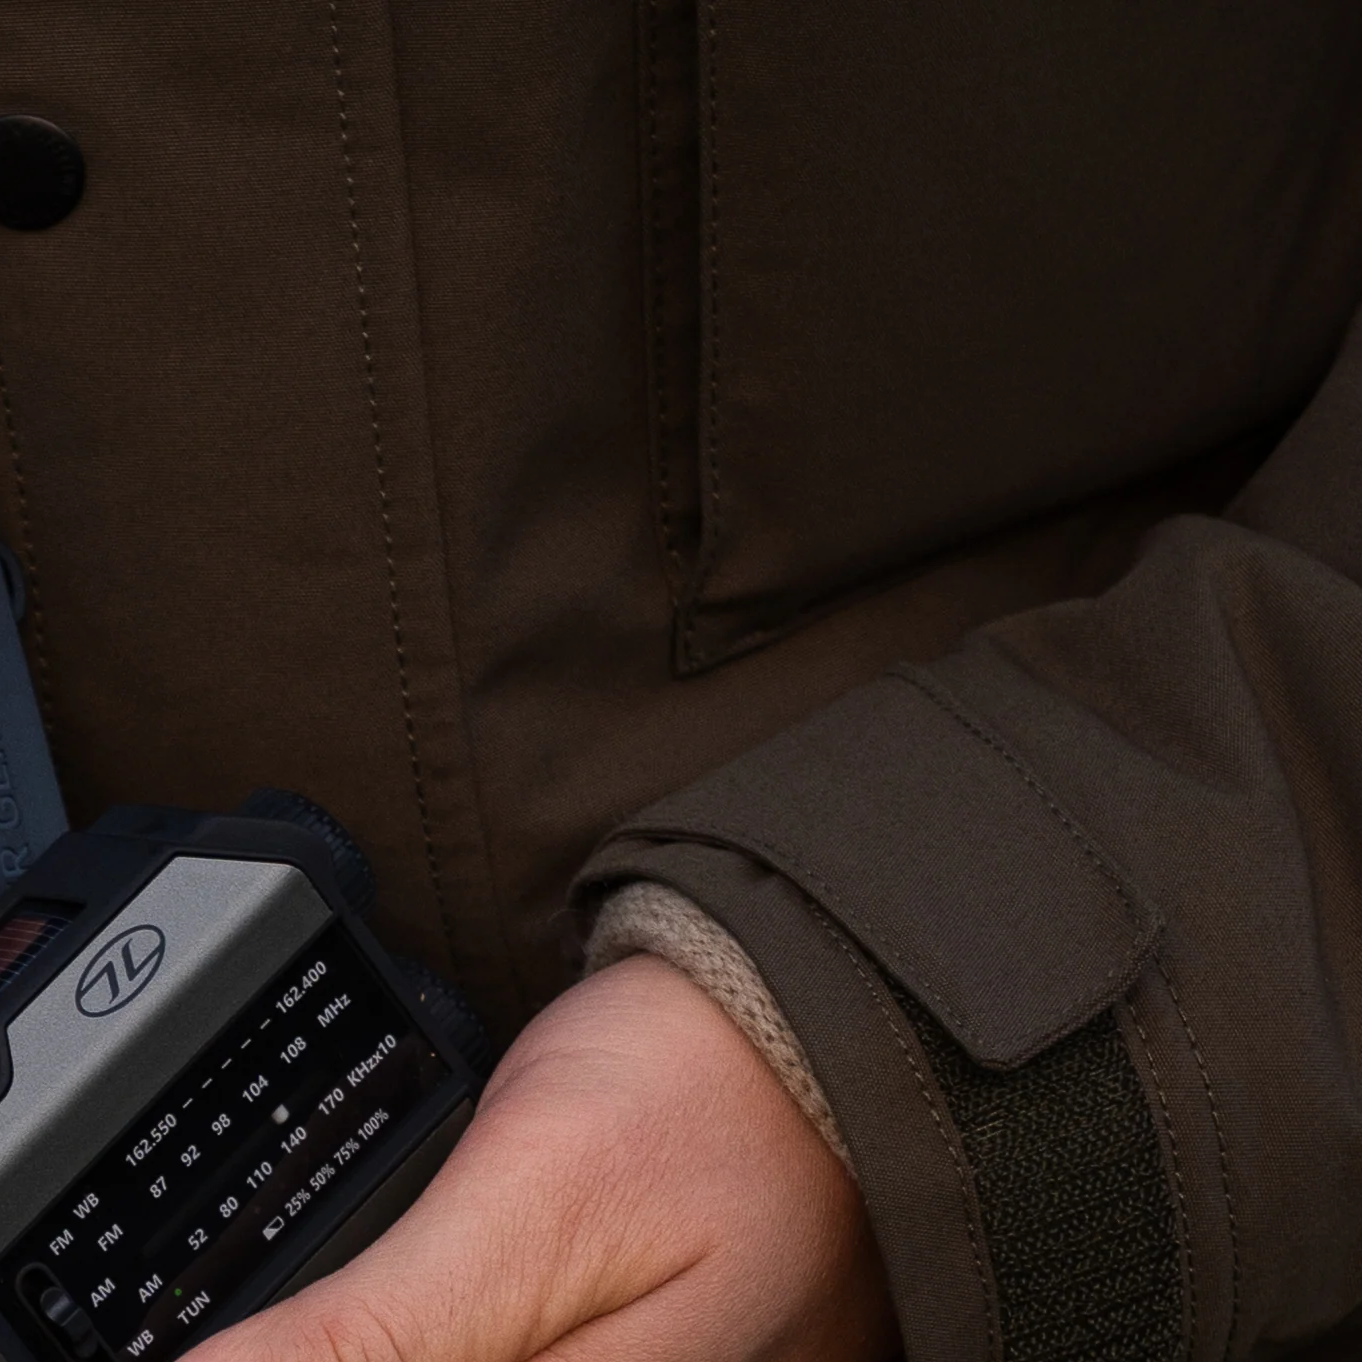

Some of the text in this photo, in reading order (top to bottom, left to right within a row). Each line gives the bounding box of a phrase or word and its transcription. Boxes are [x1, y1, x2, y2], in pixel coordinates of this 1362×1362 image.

[71, 960, 328, 1220] WB 162.550 162.400
[96, 993, 352, 1253] FM 87 92 98 104 108 MHz
[137, 1033, 397, 1304] AM 52 80 110 140 170 KHzx10
[284, 1107, 390, 1218] 25% 50% 75% 100%
[48, 1228, 75, 1257] FM
[89, 1276, 117, 1309] AM
[176, 1289, 212, 1326] TUN
[125, 1328, 155, 1358] WB
